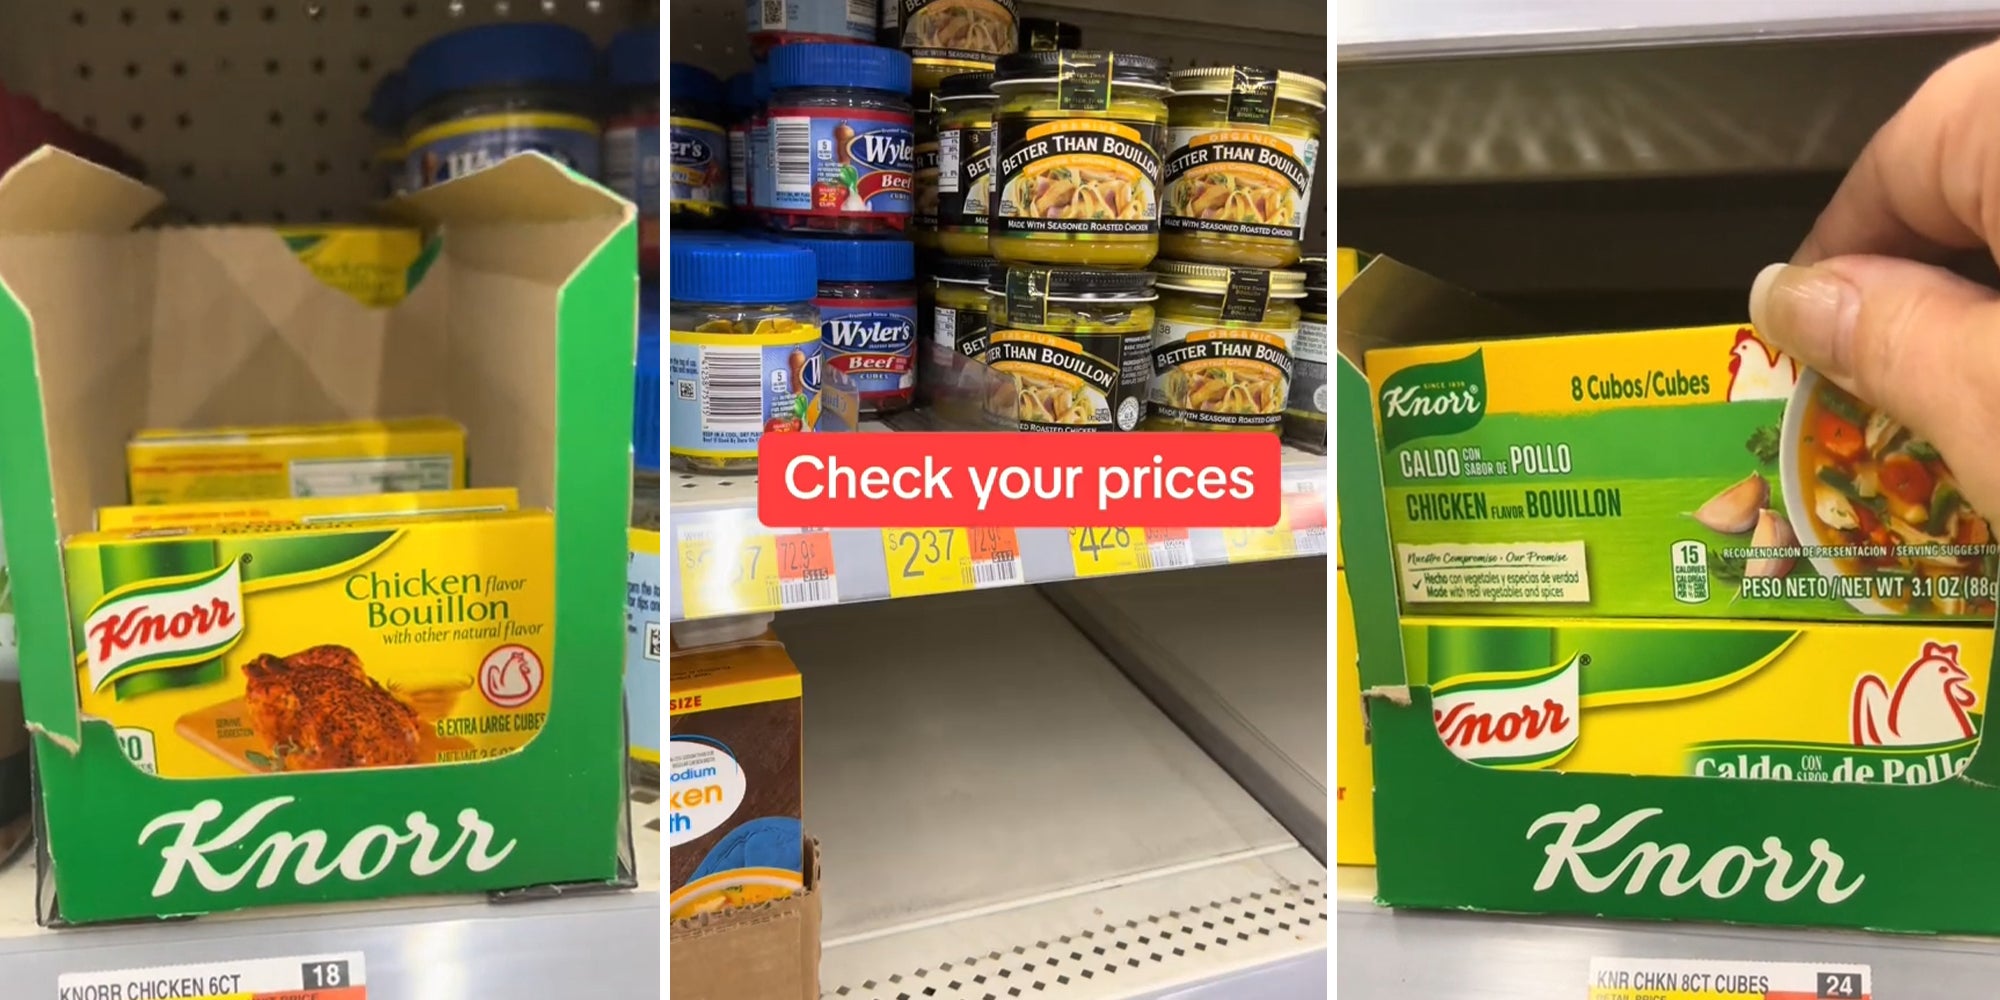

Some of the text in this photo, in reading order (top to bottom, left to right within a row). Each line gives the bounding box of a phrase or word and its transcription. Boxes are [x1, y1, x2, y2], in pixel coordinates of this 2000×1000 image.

[1001, 135, 1159, 181] BETTER THAN BOUILLON
[1164, 145, 1308, 191] BETTER THAN BOUILLON
[1008, 219, 1149, 232] MADE WITH SEASONED ROASTED CHICKEN
[1181, 219, 1200, 229] WITH
[1200, 221, 1239, 233] SEASONED
[1239, 224, 1271, 236] ROASTED
[829, 320, 910, 348] Wyler's
[1158, 325, 1171, 335] 38
[1207, 329, 1272, 344] ORGANIC
[848, 356, 896, 369] Beef
[1003, 343, 1037, 361] THAN
[1041, 347, 1113, 389] BOUILLON
[1157, 343, 1207, 369] BETTER
[1211, 341, 1252, 356] THAN
[1423, 382, 1446, 390] SINCE
[1571, 368, 1711, 402] 8 Cubos/Cubes
[1383, 385, 1480, 418] Knorr
[1030, 424, 1064, 432] ROASTED
[1199, 413, 1237, 423] SEASONED
[1238, 415, 1264, 425] ROASTED
[1400, 443, 1571, 478] CALDO CON SABOR DE POLLO
[1406, 488, 1622, 522] CHICKEN FLAVOR BOUILLON
[1408, 551, 1568, 566] Nuestro Compromiso Our Promise
[1681, 545, 1699, 564] 15
[1723, 545, 1801, 558] RECOMENDACIÓN
[1802, 546, 1815, 557] DE
[1816, 545, 1887, 557] PRESENTACIÓN
[1896, 545, 1939, 556] SERVING
[345, 568, 527, 601] Chicken flavor
[1424, 572, 1449, 584] Hecho
[1450, 574, 1463, 584] con
[1464, 571, 1501, 587] vegetales
[1507, 573, 1540, 586] especias
[1541, 571, 1551, 584] de
[1552, 571, 1580, 584] verdad
[1742, 577, 1782, 598] PESO
[1786, 576, 1828, 598] NETO
[1842, 575, 1873, 598] NET
[1876, 575, 1905, 598] WT
[1912, 576, 1932, 598] 3.1
[1938, 576, 1960, 598] OZ
[1426, 586, 1564, 600] Made with real vegetables and spices
[367, 594, 510, 629] Bouillon
[89, 597, 236, 662] Knorr
[383, 619, 544, 645] with other natural flavor
[670, 695, 702, 711] SIZE
[437, 719, 446, 737] 6
[447, 716, 478, 737] EXTRA
[479, 713, 512, 735] LARGE
[1695, 754, 1793, 781] Caldo
[1801, 754, 1822, 770] CON
[1832, 756, 1875, 784] de
[138, 795, 517, 898] Knorr
[1526, 803, 1866, 904] Knorr
[127, 977, 204, 1000] CHICKEN
[209, 974, 242, 995] 6CT
[312, 963, 341, 988] 18
[1597, 970, 1853, 996] KNR CHKN 8CT CUBES 24
